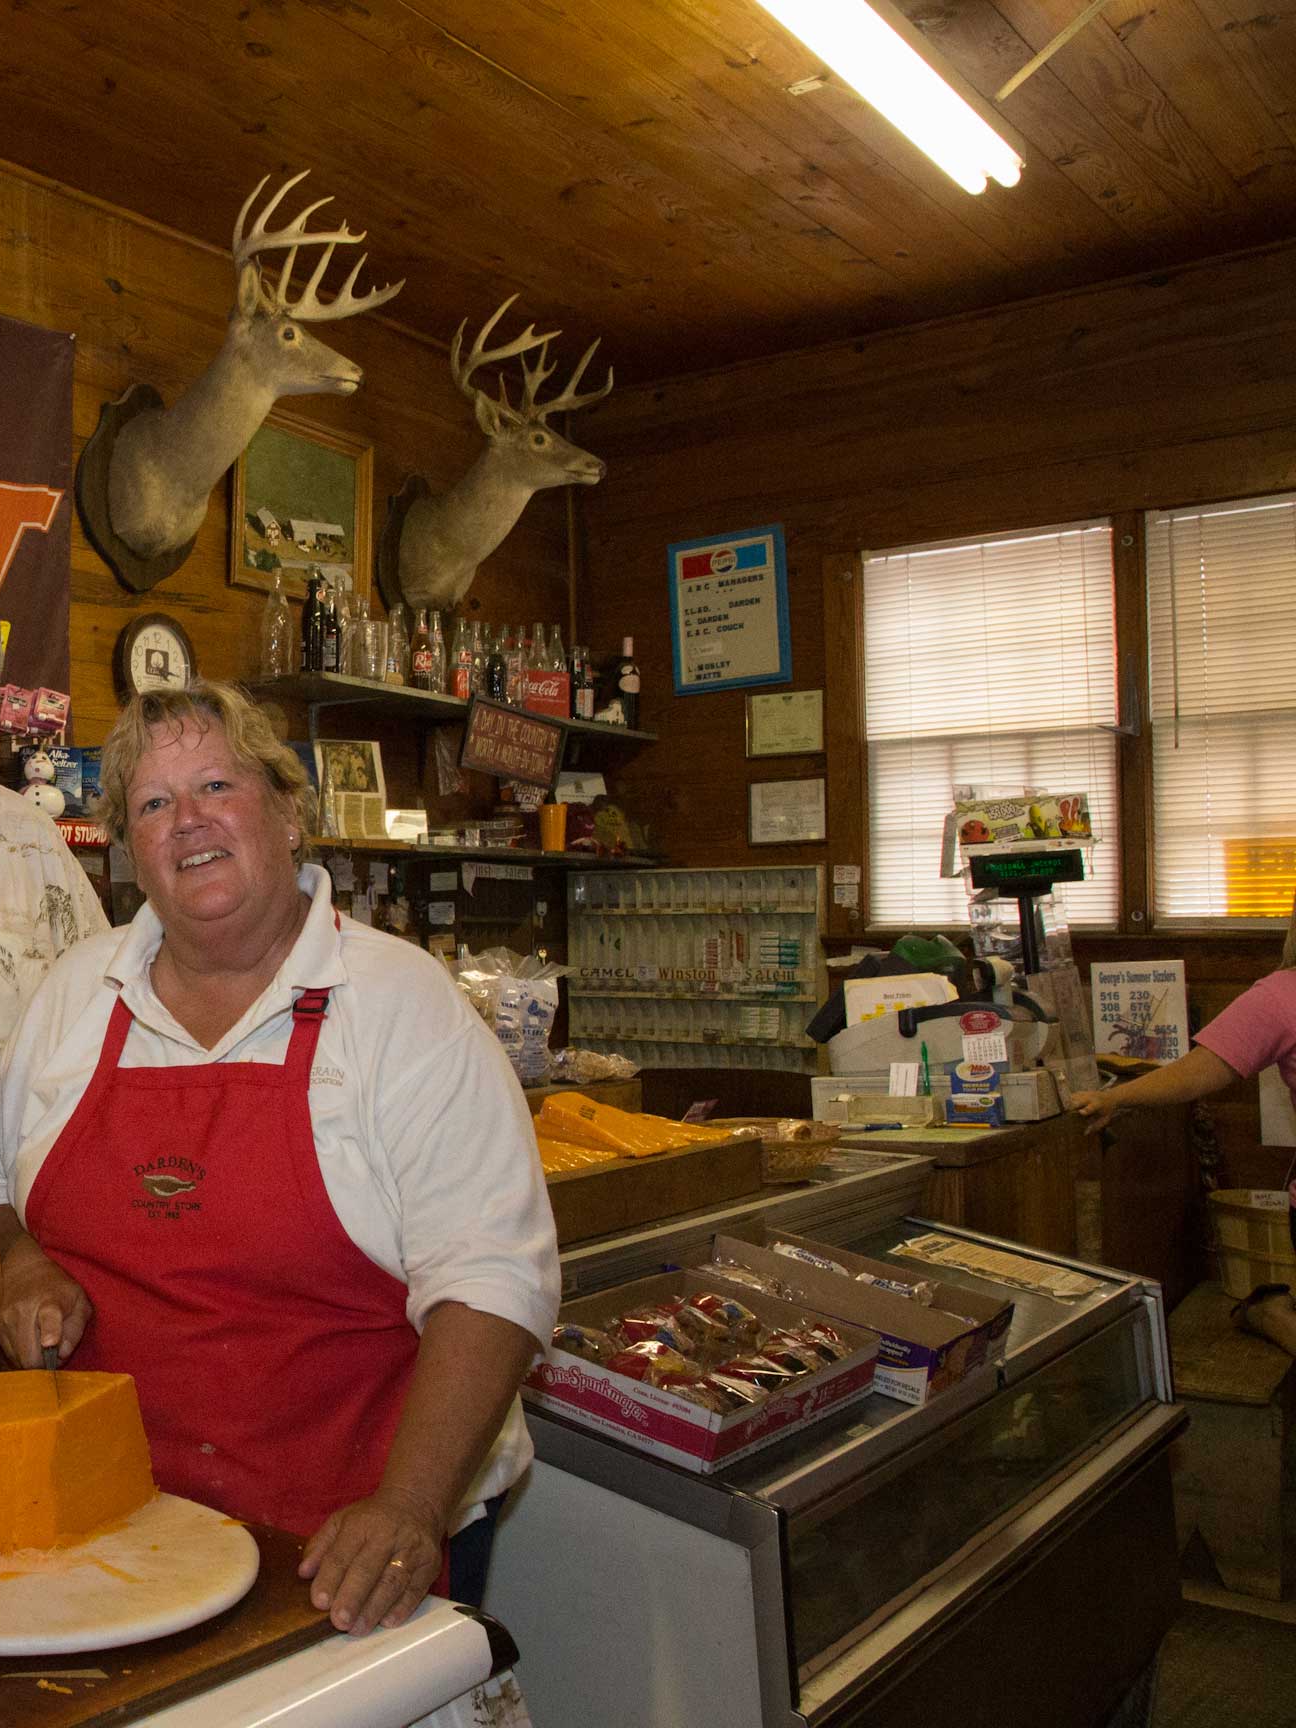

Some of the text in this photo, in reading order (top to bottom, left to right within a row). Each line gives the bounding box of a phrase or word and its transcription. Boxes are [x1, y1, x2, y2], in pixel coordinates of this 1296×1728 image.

[718, 574, 764, 588] MANAGERS
[728, 597, 761, 609] DARDEN
[697, 614, 729, 625] DARDEN
[716, 622, 745, 633] COUCH
[48, 749, 70, 759] Alka-
[51, 758, 79, 769] Seltzer
[74, 825, 108, 844] STUPID
[580, 967, 635, 979] CAMEL
[658, 967, 717, 981] Winston
[1099, 970, 1125, 987] George's
[1126, 970, 1152, 984] Summer
[1129, 990, 1150, 1001] 230
[134, 1156, 207, 1181] DARDEN'S
[542, 1363, 570, 1385] Otis
